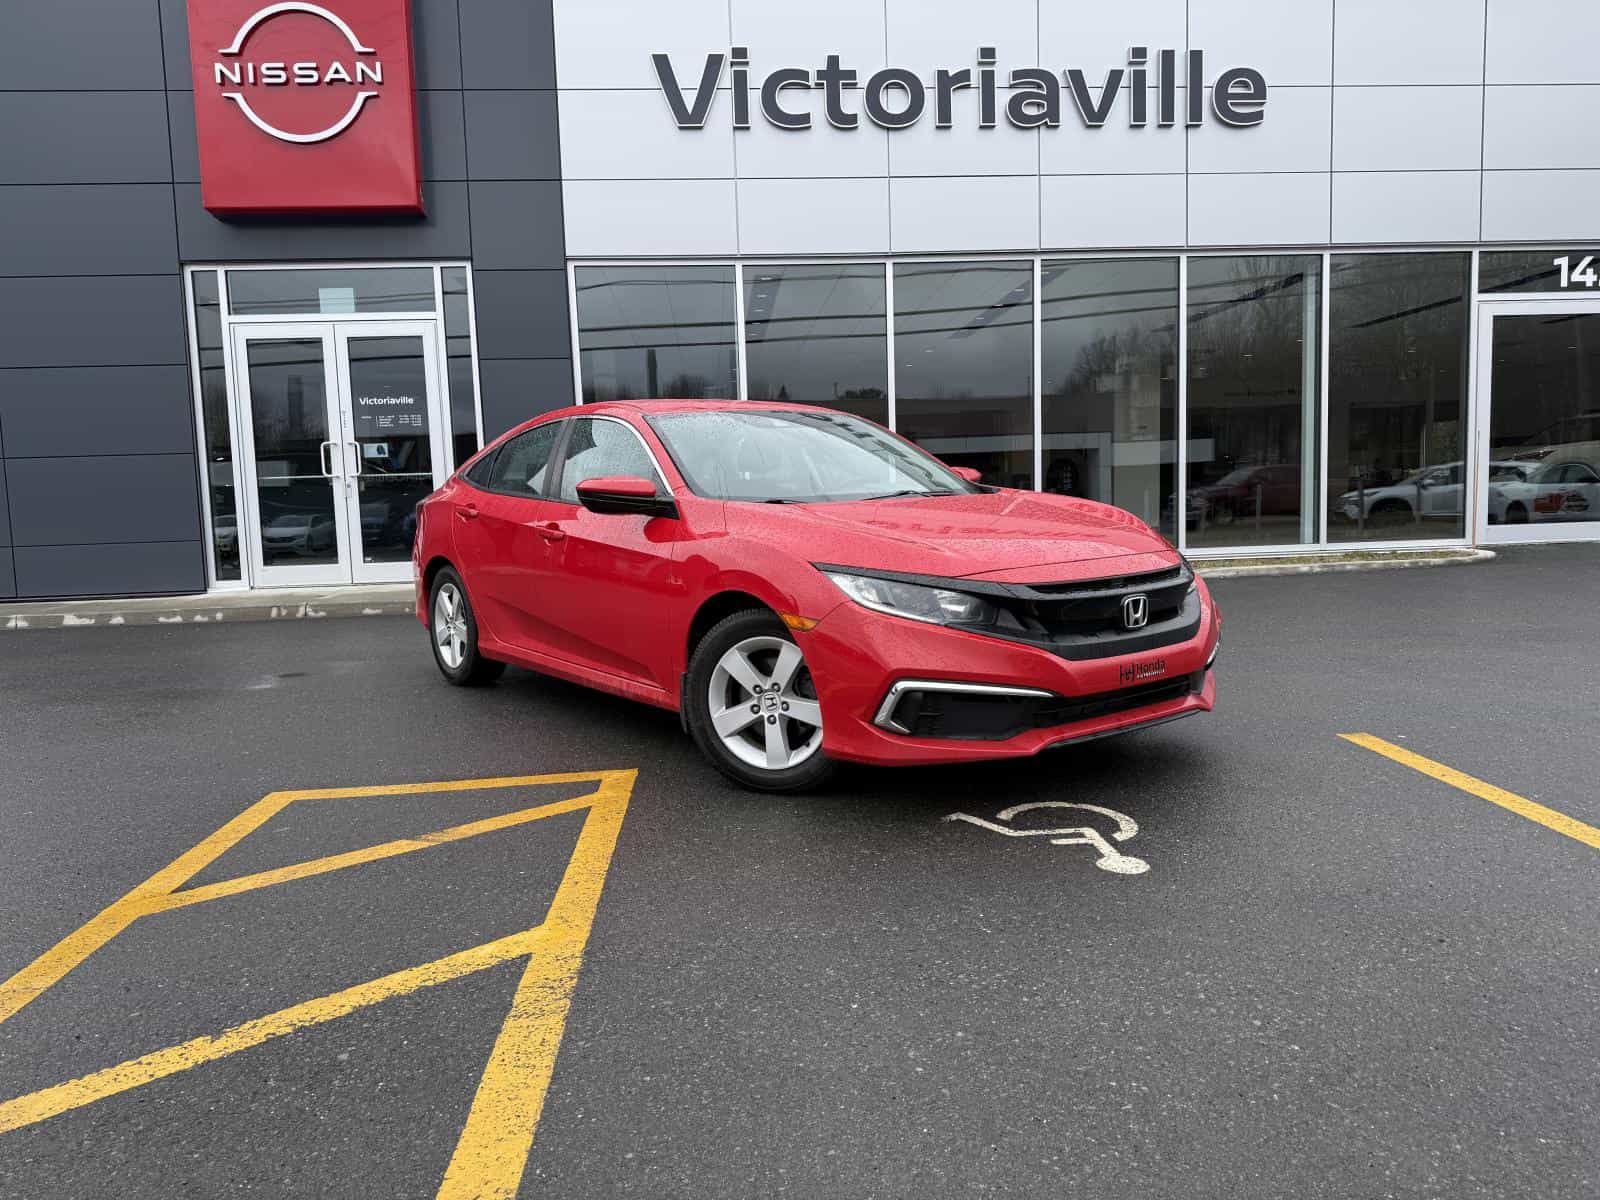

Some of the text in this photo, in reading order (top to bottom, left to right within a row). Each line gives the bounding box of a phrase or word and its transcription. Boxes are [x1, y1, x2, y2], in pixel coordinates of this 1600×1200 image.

[214, 61, 383, 84] NISSAN
[651, 46, 1267, 129] Victoriaville
[1553, 255, 1600, 288] 14
[359, 395, 414, 405] Victoriaville
[1136, 658, 1166, 674] Honda
